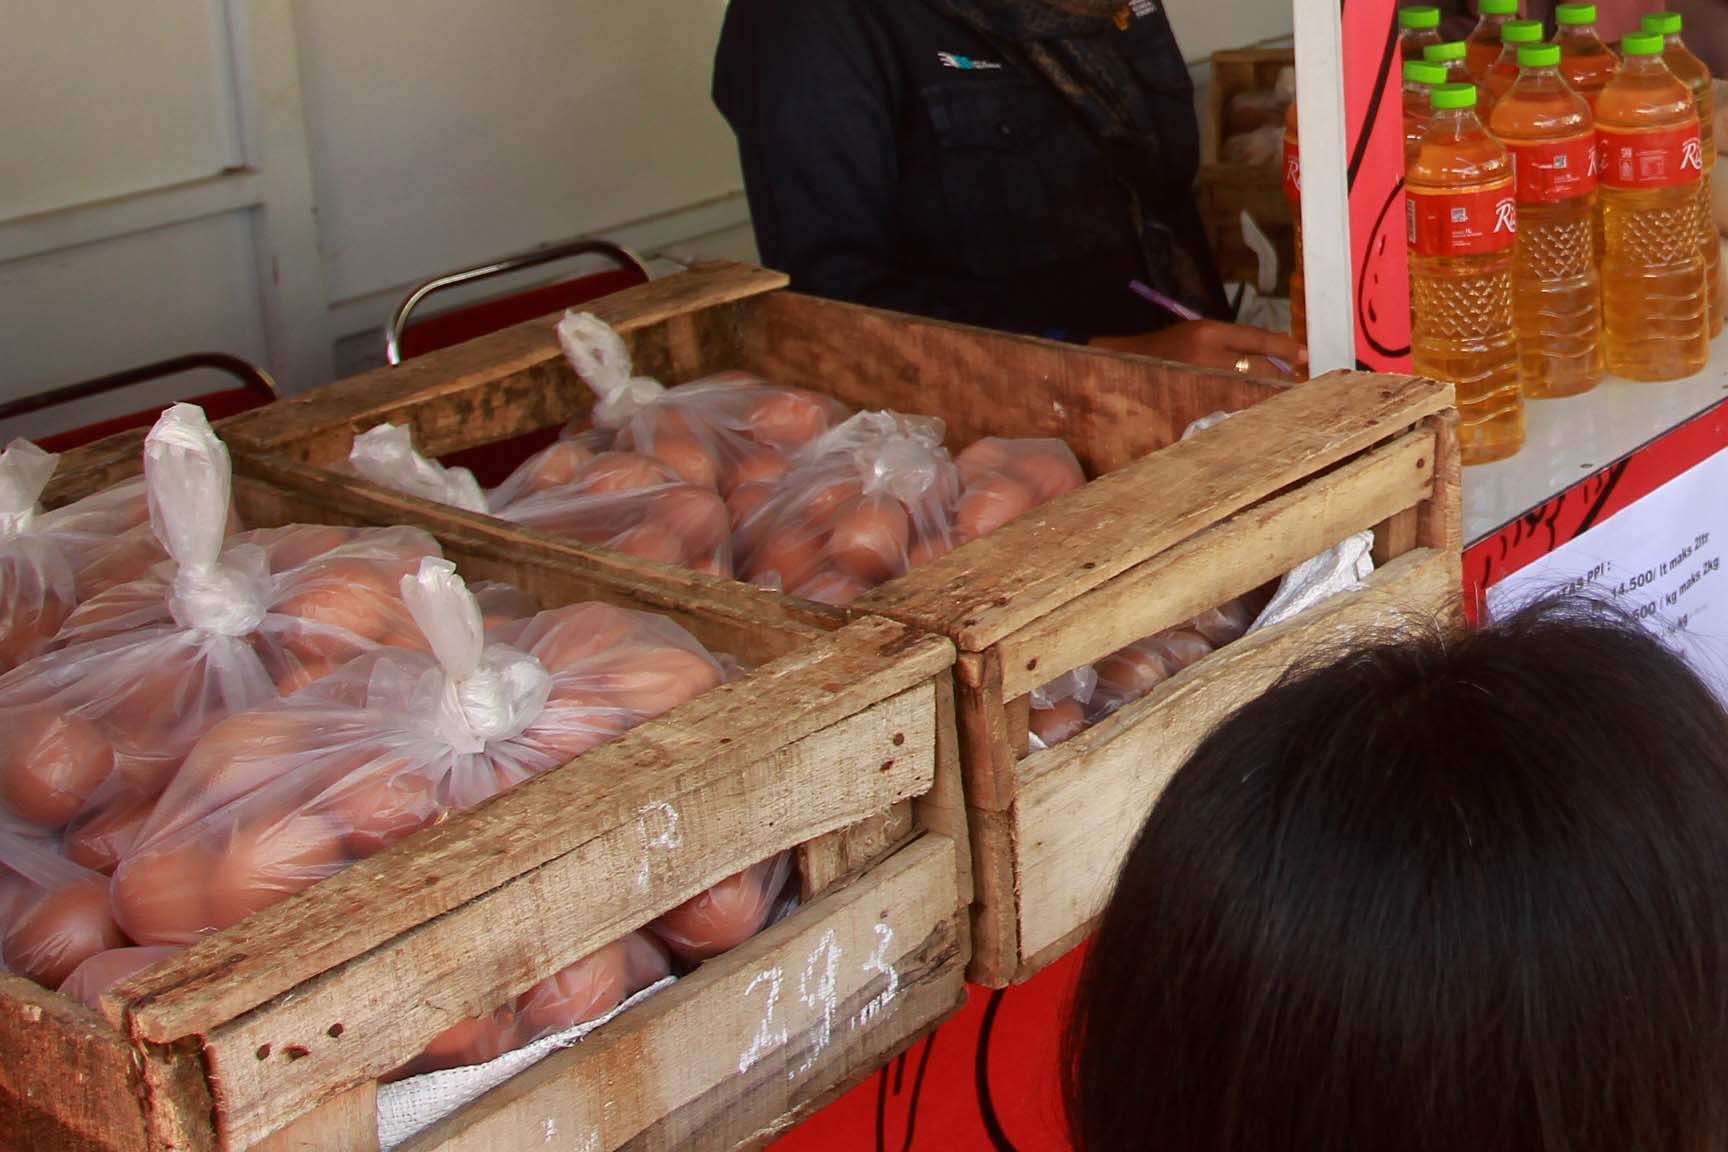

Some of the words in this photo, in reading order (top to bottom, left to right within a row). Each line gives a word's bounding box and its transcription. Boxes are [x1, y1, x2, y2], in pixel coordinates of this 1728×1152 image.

[1669, 546, 1692, 570] maks
[1586, 562, 1604, 584] PPI
[1665, 591, 1677, 606] kg
[1679, 570, 1701, 594] maks
[1703, 557, 1719, 575] 2kg
